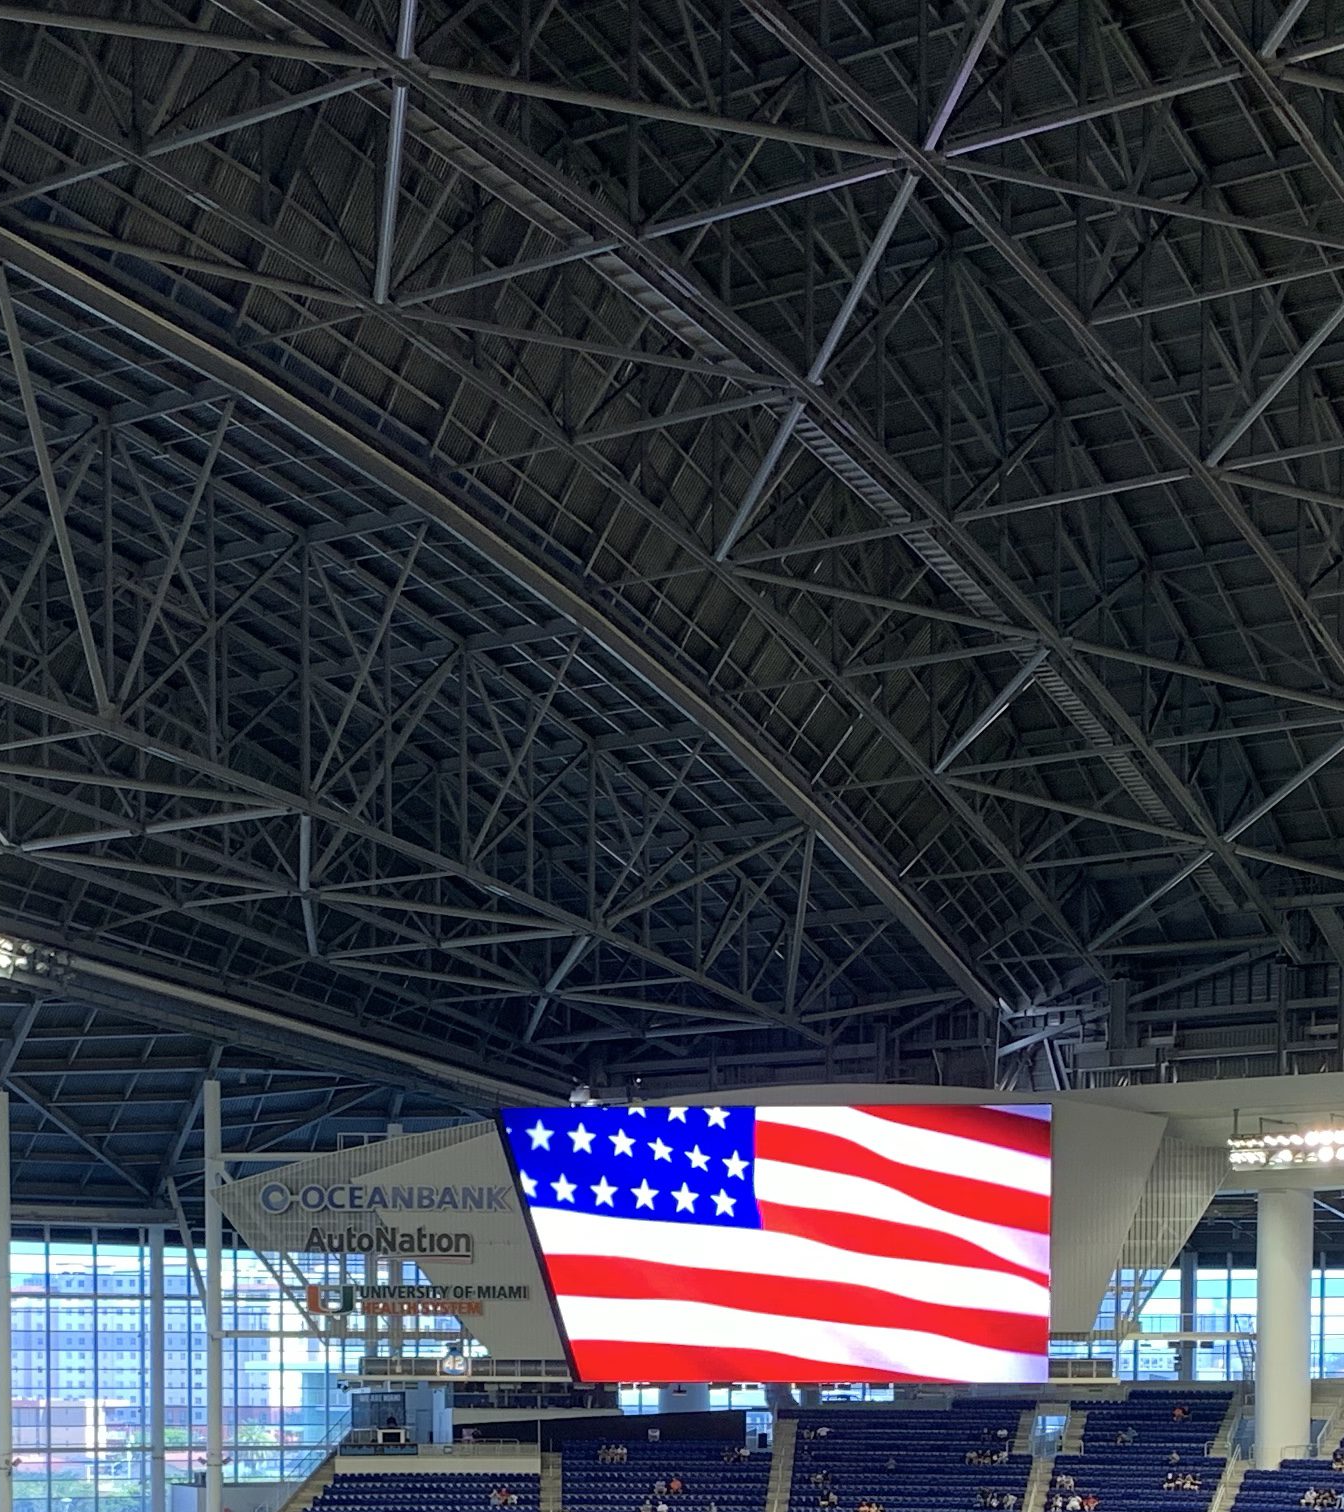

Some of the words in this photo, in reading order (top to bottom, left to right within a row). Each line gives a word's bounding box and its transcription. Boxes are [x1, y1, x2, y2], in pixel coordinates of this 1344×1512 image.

[306, 1227, 471, 1254] AutoNation
[361, 1285, 449, 1299] UNIVERSITY
[452, 1286, 476, 1299] OF
[478, 1286, 529, 1299] MIAMI
[361, 1301, 418, 1315] HEALTH
[420, 1301, 481, 1316] SYSTEM
[443, 1357, 464, 1370] 42
